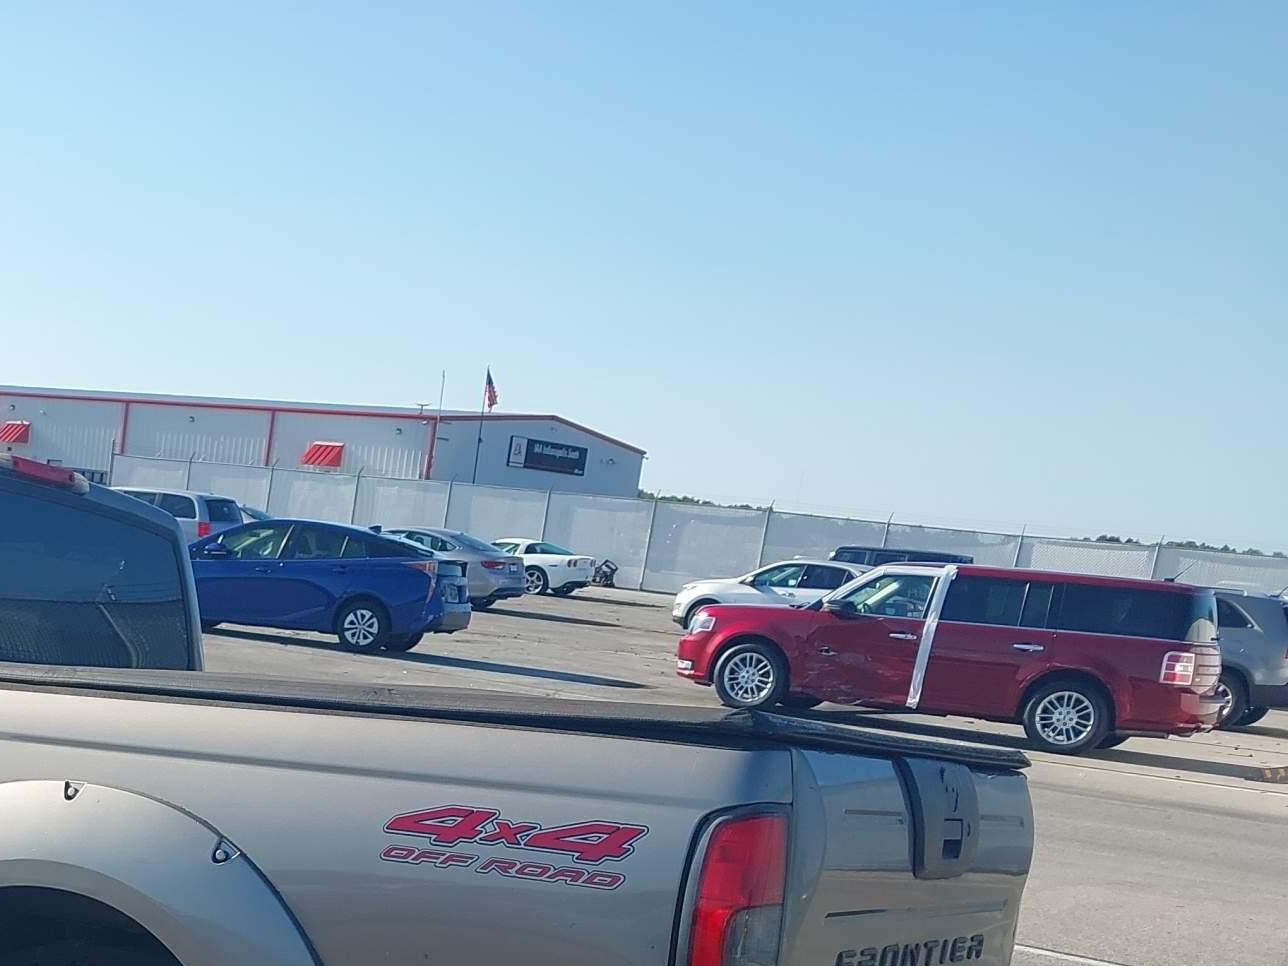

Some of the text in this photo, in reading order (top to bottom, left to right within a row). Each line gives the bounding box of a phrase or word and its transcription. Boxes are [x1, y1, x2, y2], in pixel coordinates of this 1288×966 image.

[383, 804, 650, 866] 4x4
[380, 844, 626, 890] OFF ROAD
